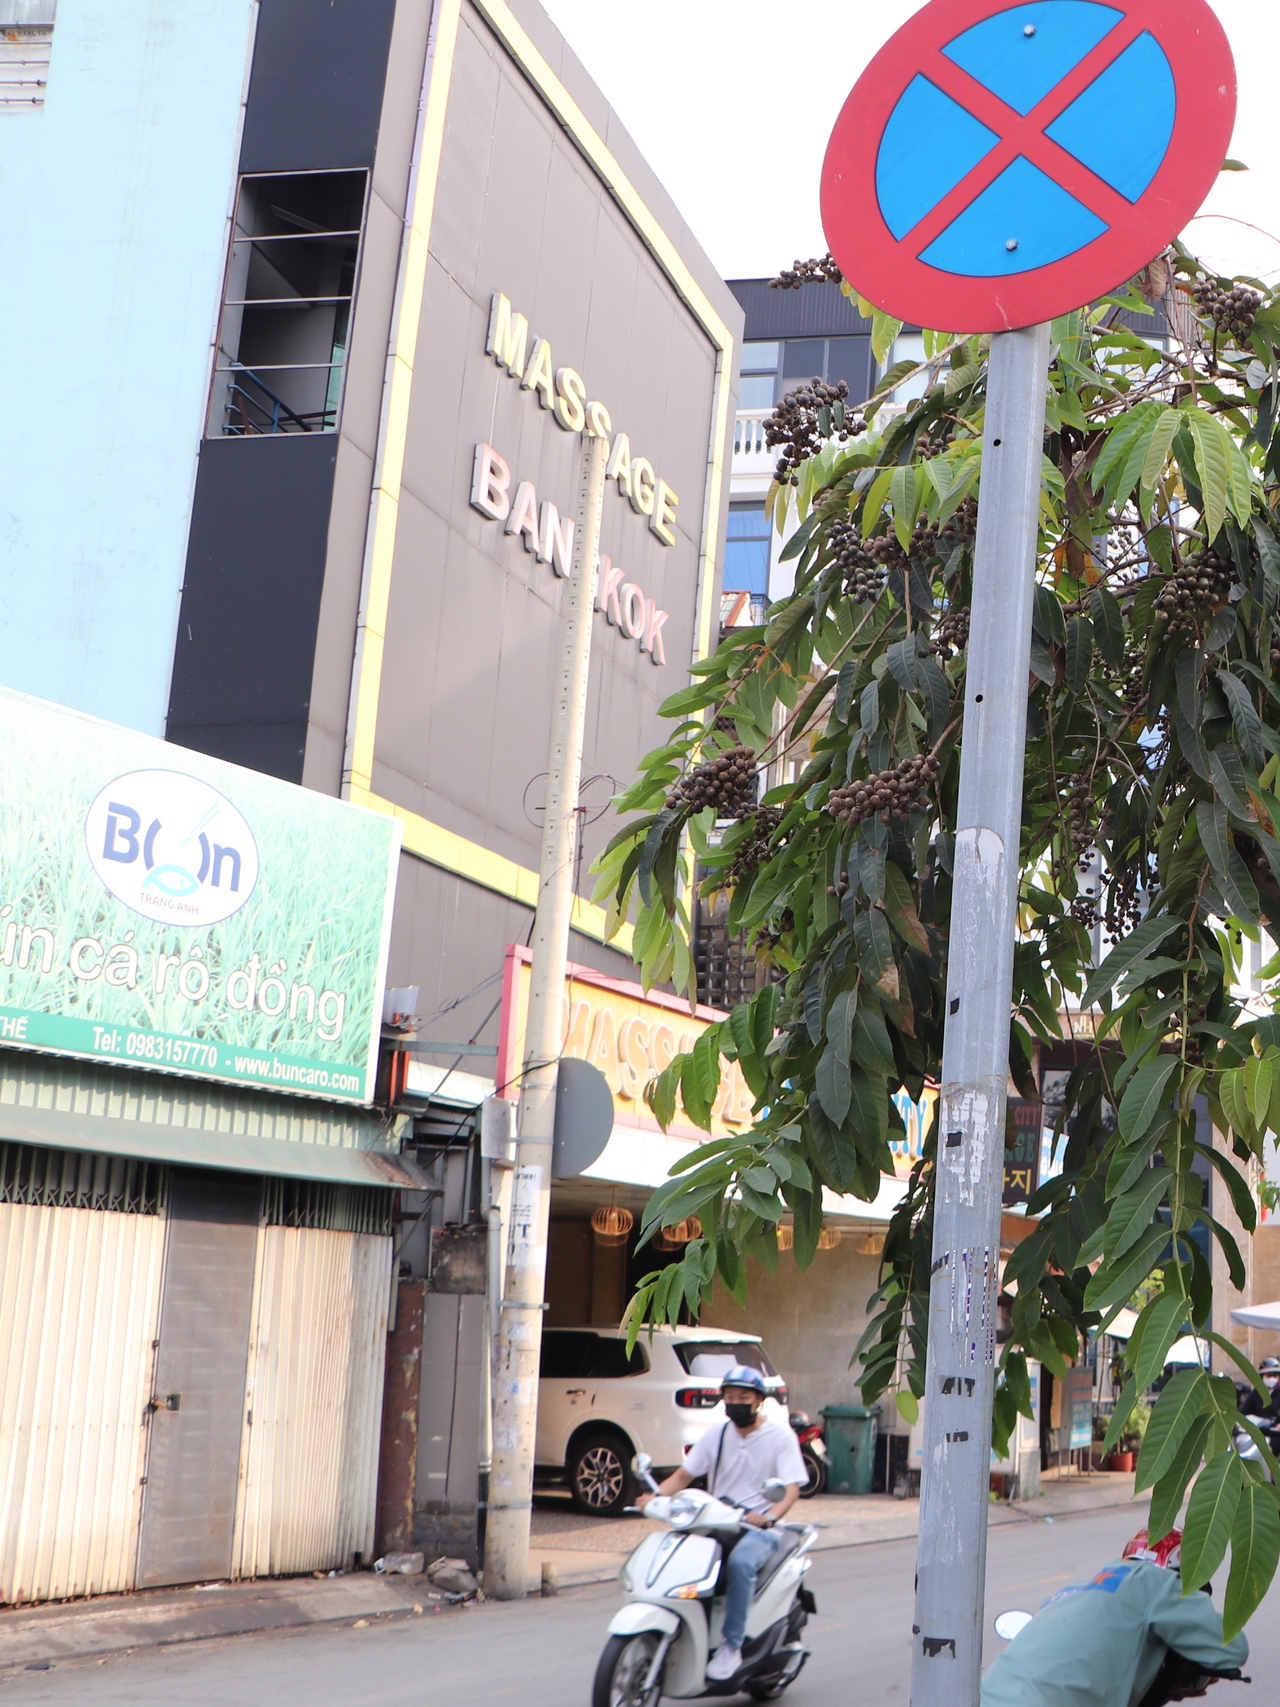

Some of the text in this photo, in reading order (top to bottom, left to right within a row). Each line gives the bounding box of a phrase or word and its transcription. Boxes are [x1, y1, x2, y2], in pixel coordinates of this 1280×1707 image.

[470, 443, 669, 667] BANKOK
[139, 892, 200, 915] TRANG ANH
[69, 930, 139, 990] cá
[155, 945, 210, 1001] rô
[226, 951, 346, 1042] đồng
[93, 1026, 122, 1053] Tel:
[126, 1031, 218, 1069] 0983157770
[234, 1055, 360, 1093] www.buncaro.com
[1014, 1106, 1039, 1126] CITY
